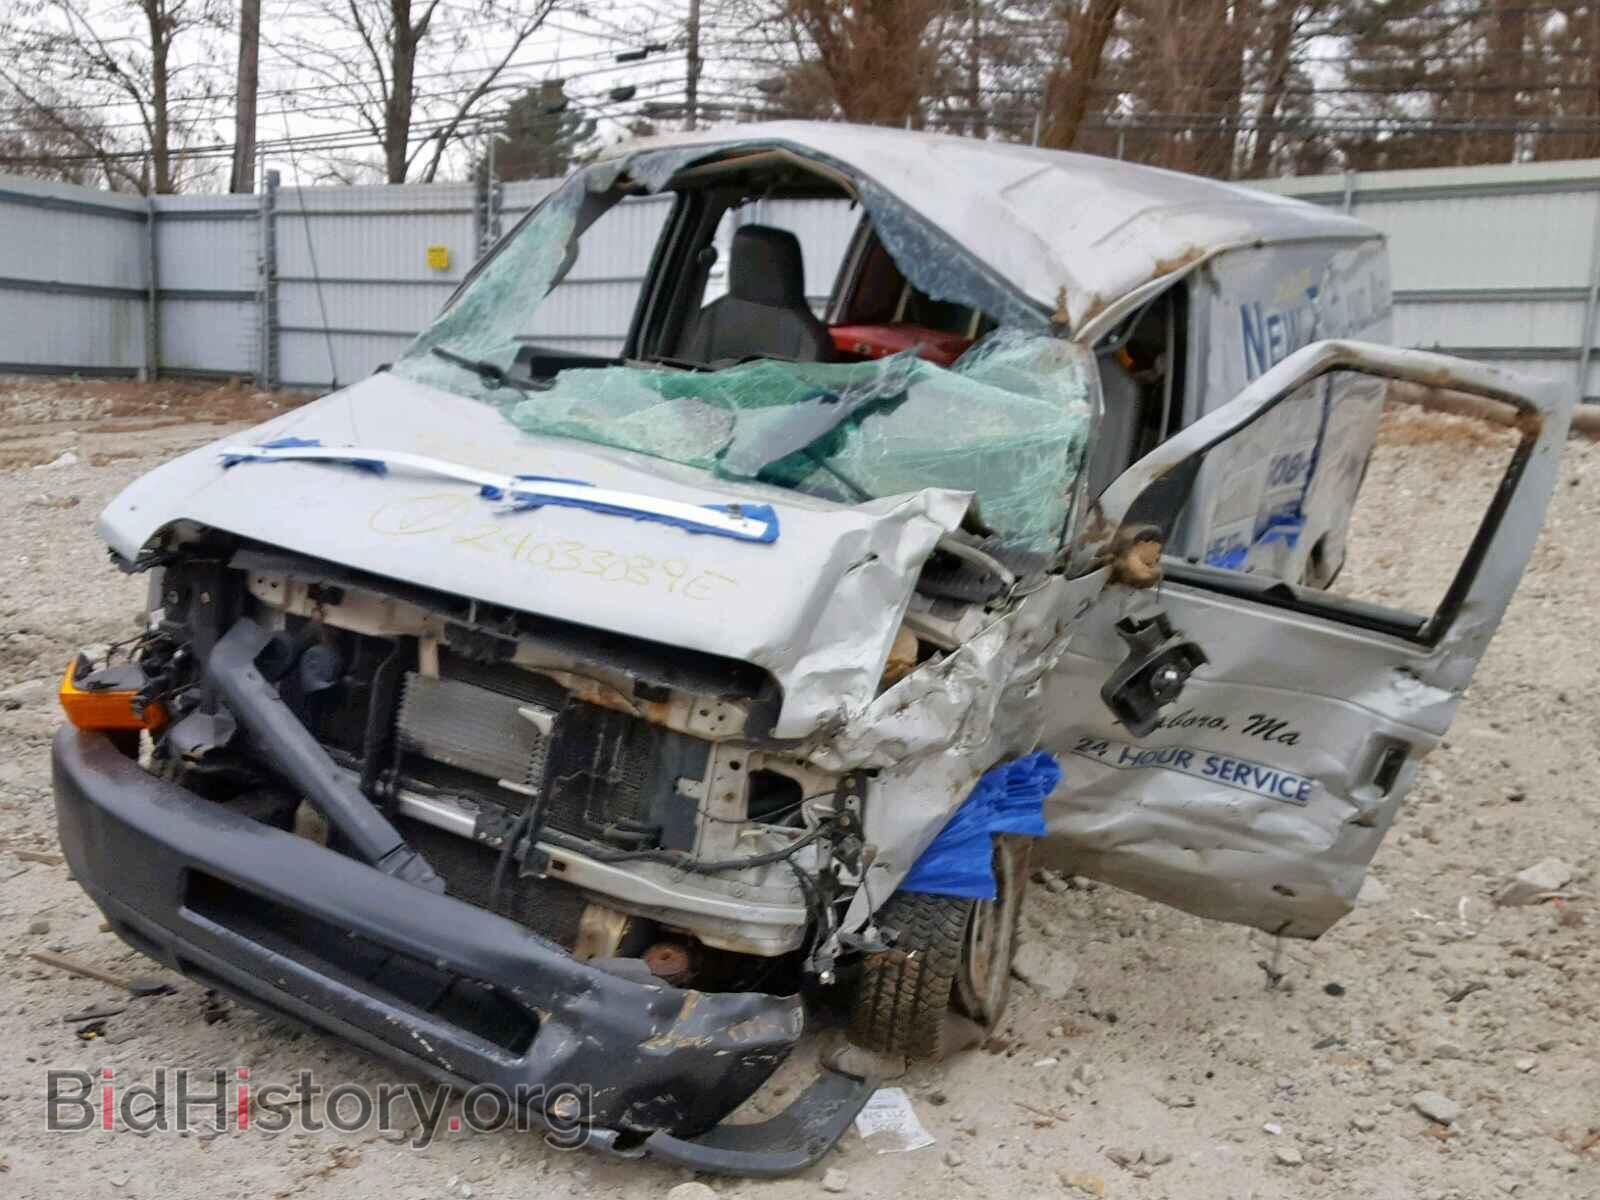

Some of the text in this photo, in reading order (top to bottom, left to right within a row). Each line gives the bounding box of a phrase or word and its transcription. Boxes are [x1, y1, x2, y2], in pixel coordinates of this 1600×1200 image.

[1240, 713, 1301, 746] Ma
[1117, 746, 1194, 769] HOUR
[1201, 755, 1314, 801] SERVICE
